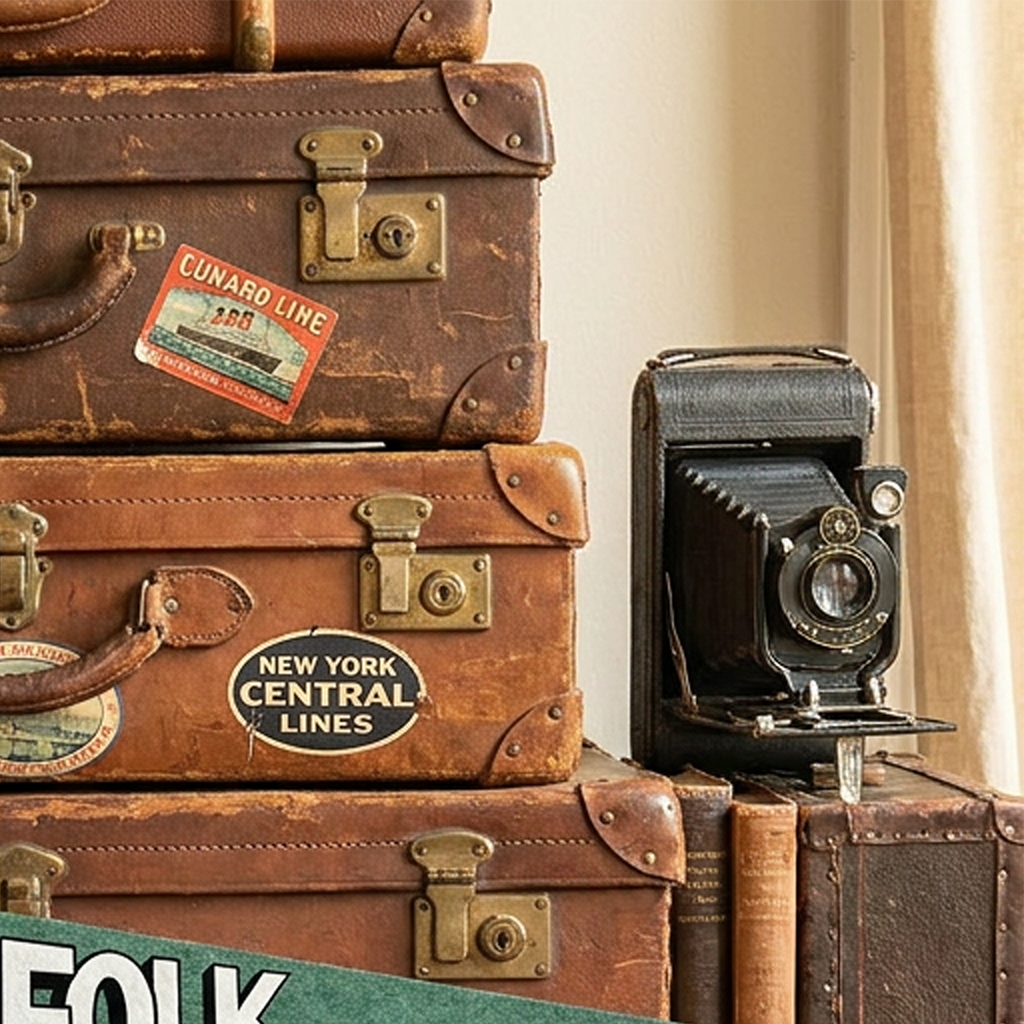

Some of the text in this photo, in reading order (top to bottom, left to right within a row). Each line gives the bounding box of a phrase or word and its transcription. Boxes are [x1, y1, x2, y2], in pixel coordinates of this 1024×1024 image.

[274, 295, 328, 335] LINE
[259, 655, 397, 676] NEW YORK
[239, 681, 415, 707] CENTRAL
[280, 713, 373, 734] LINES
